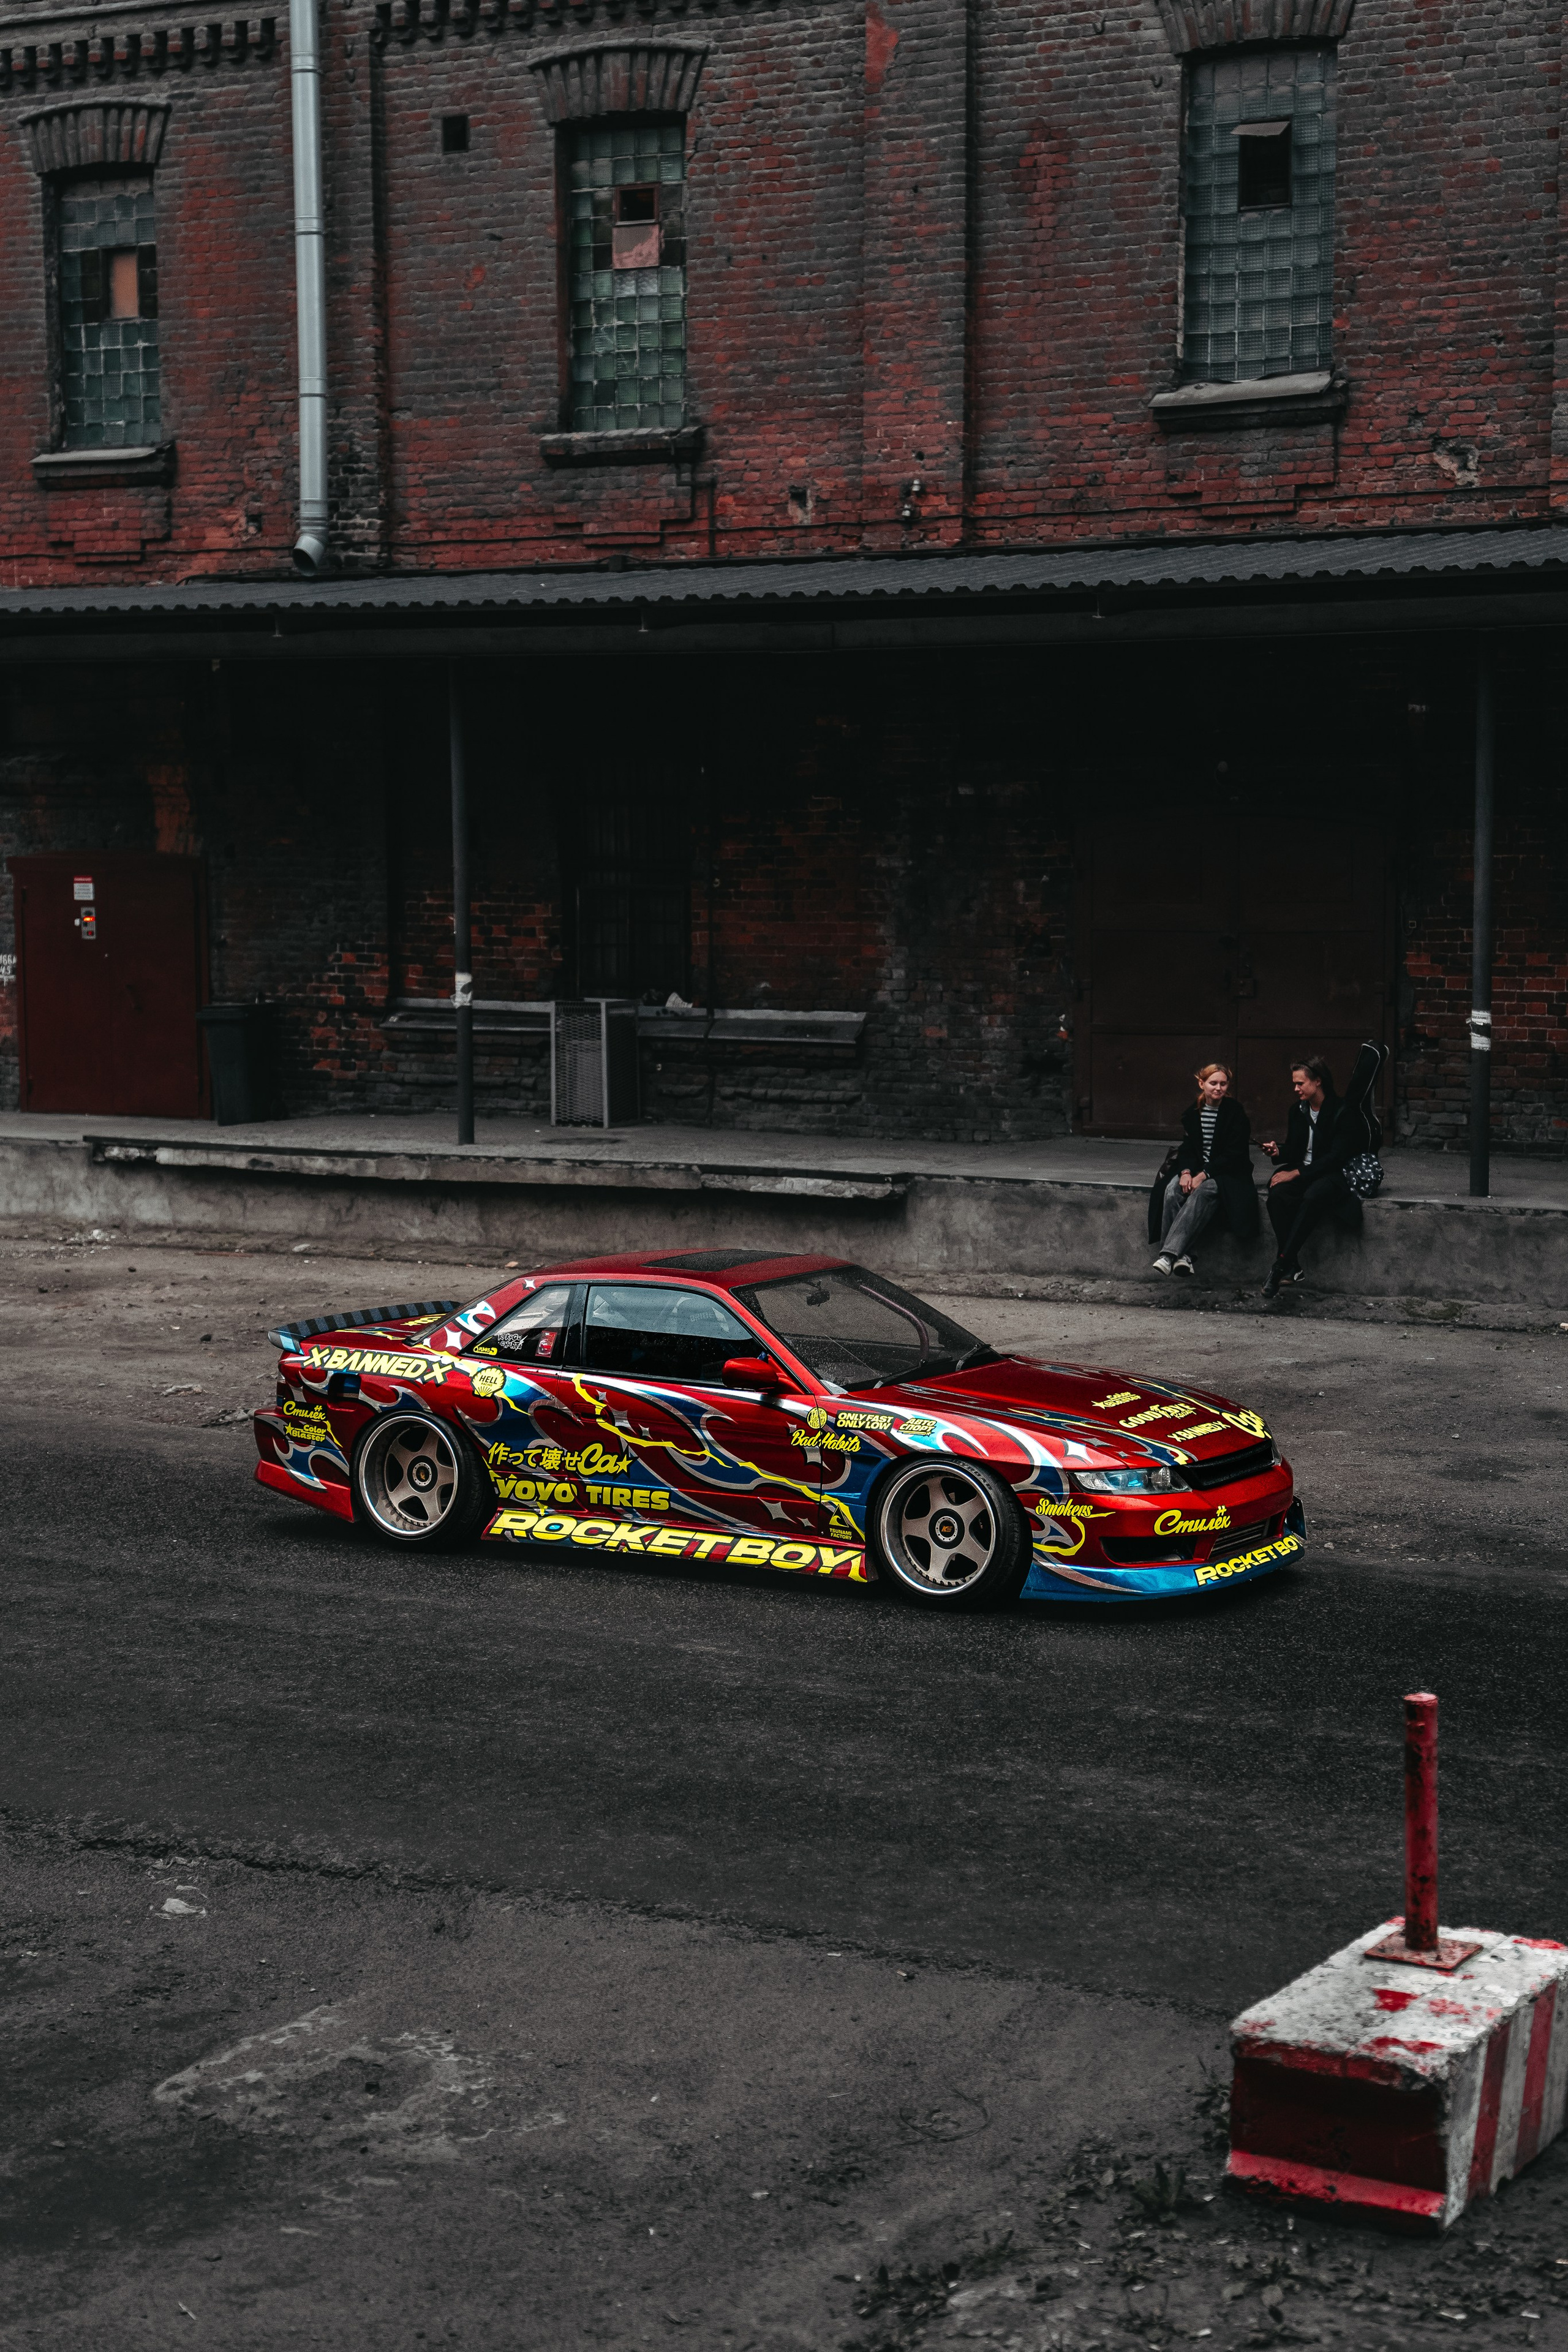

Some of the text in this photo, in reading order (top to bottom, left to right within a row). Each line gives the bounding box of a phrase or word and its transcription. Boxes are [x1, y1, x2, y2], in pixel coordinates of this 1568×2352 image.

[479, 1375, 497, 1384] HELL
[838, 1412, 894, 1423] ONLY FAST
[1119, 1411, 1163, 1428] GOOD
[303, 1424, 326, 1434] Color
[837, 1420, 891, 1430] ONLY LOW
[292, 1430, 325, 1442] Blaster
[791, 1430, 861, 1452] Bad Habits
[488, 1442, 581, 1471] 作って壊せ
[497, 1479, 669, 1510] YOYO TIRES
[1035, 1498, 1093, 1517] Smokers
